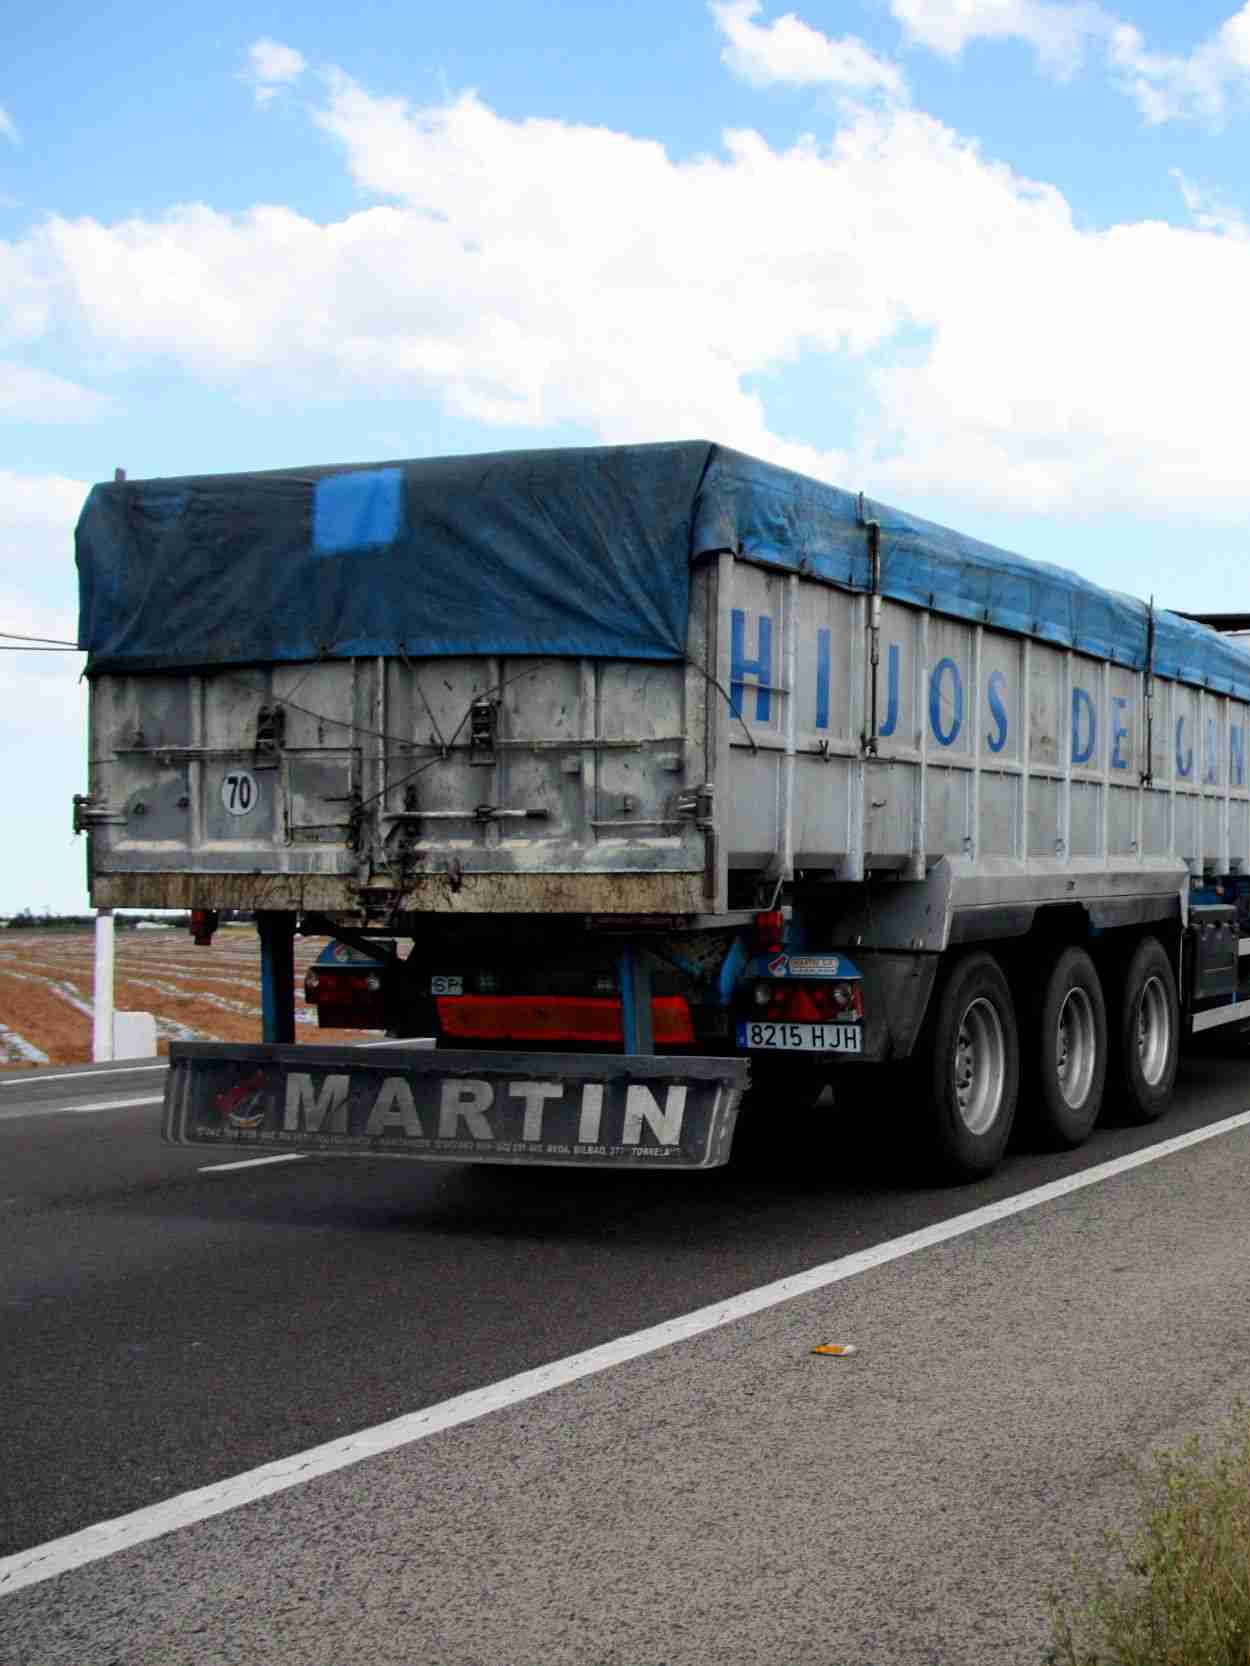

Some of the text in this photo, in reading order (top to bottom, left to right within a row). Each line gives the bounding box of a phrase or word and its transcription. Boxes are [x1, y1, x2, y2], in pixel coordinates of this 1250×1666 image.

[729, 607, 1009, 754] HIJOS
[1071, 687, 1129, 770] DE
[227, 776, 251, 809] 70
[751, 1024, 858, 1049] 8215 HJH
[283, 1071, 689, 1148] MARTIN
